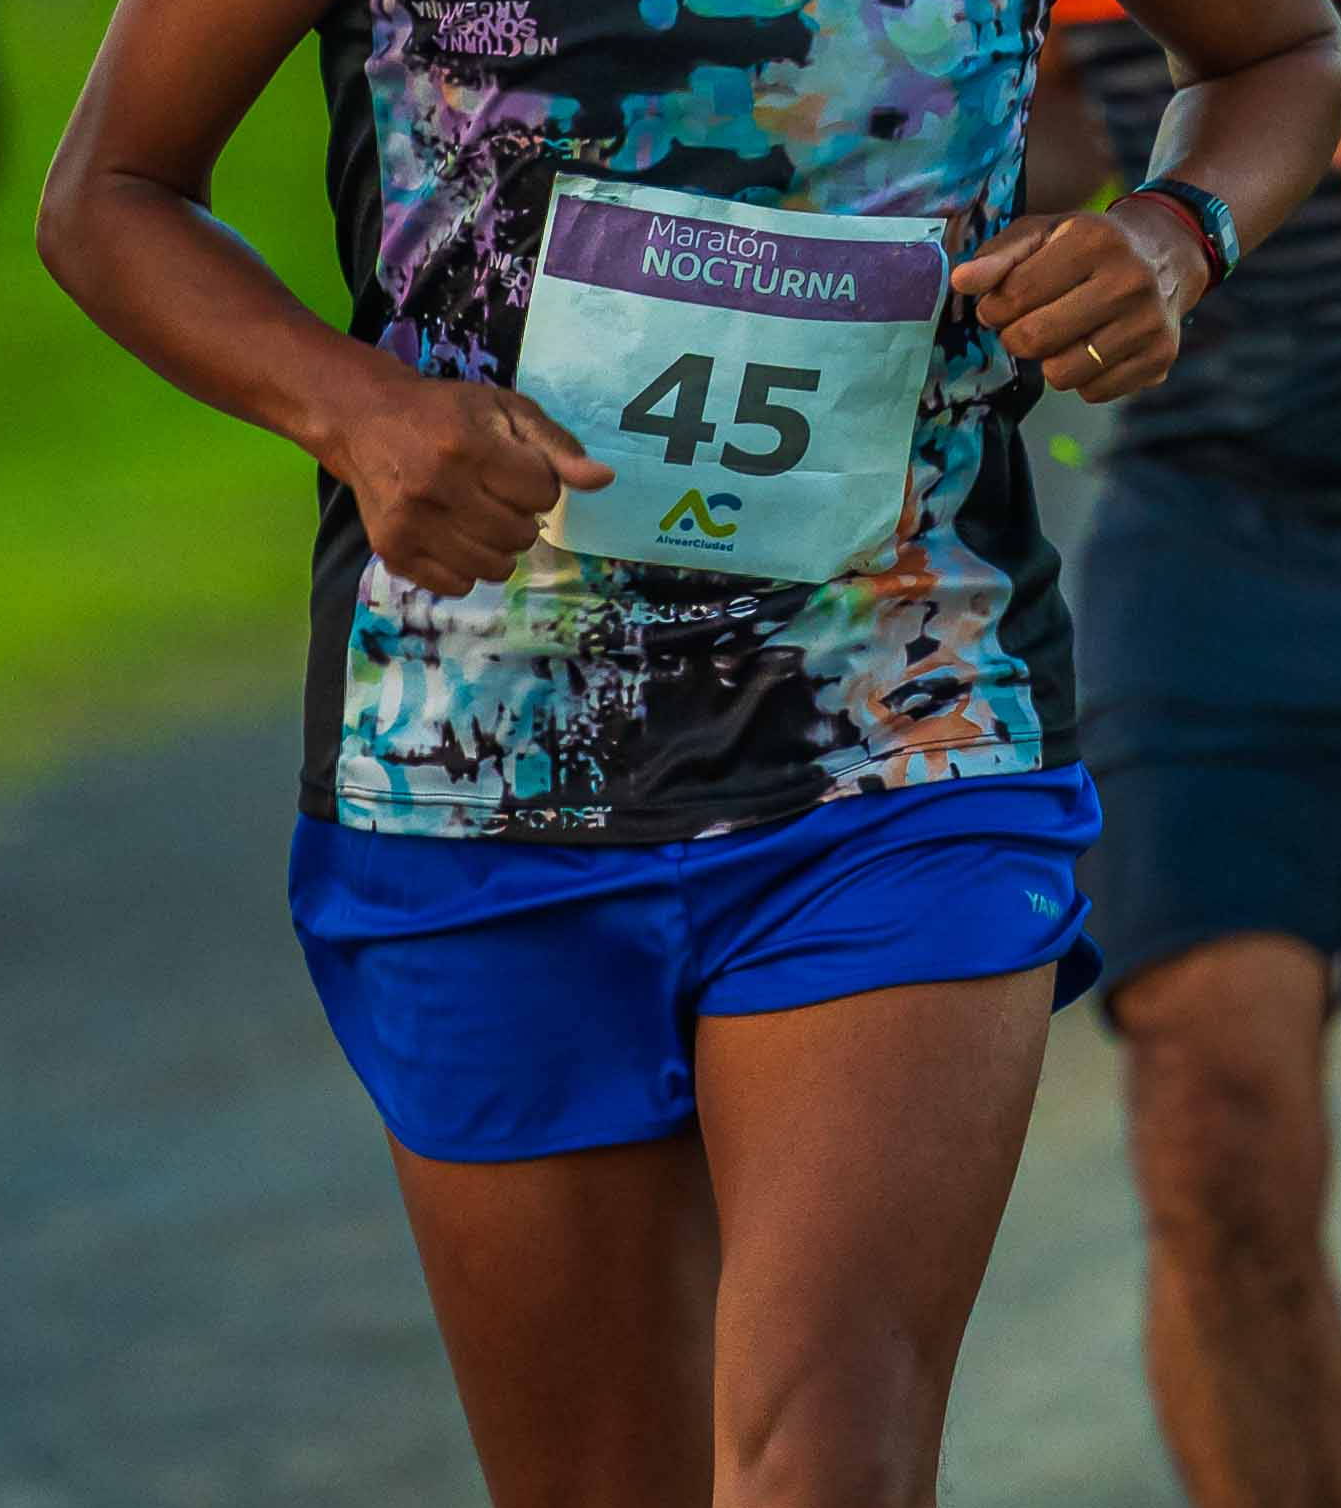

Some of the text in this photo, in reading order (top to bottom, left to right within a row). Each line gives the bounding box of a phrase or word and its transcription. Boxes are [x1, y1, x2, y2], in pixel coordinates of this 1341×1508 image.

[647, 216, 778, 262] Maratón
[641, 246, 858, 302] NOCTURNA
[619, 352, 821, 476] 45
